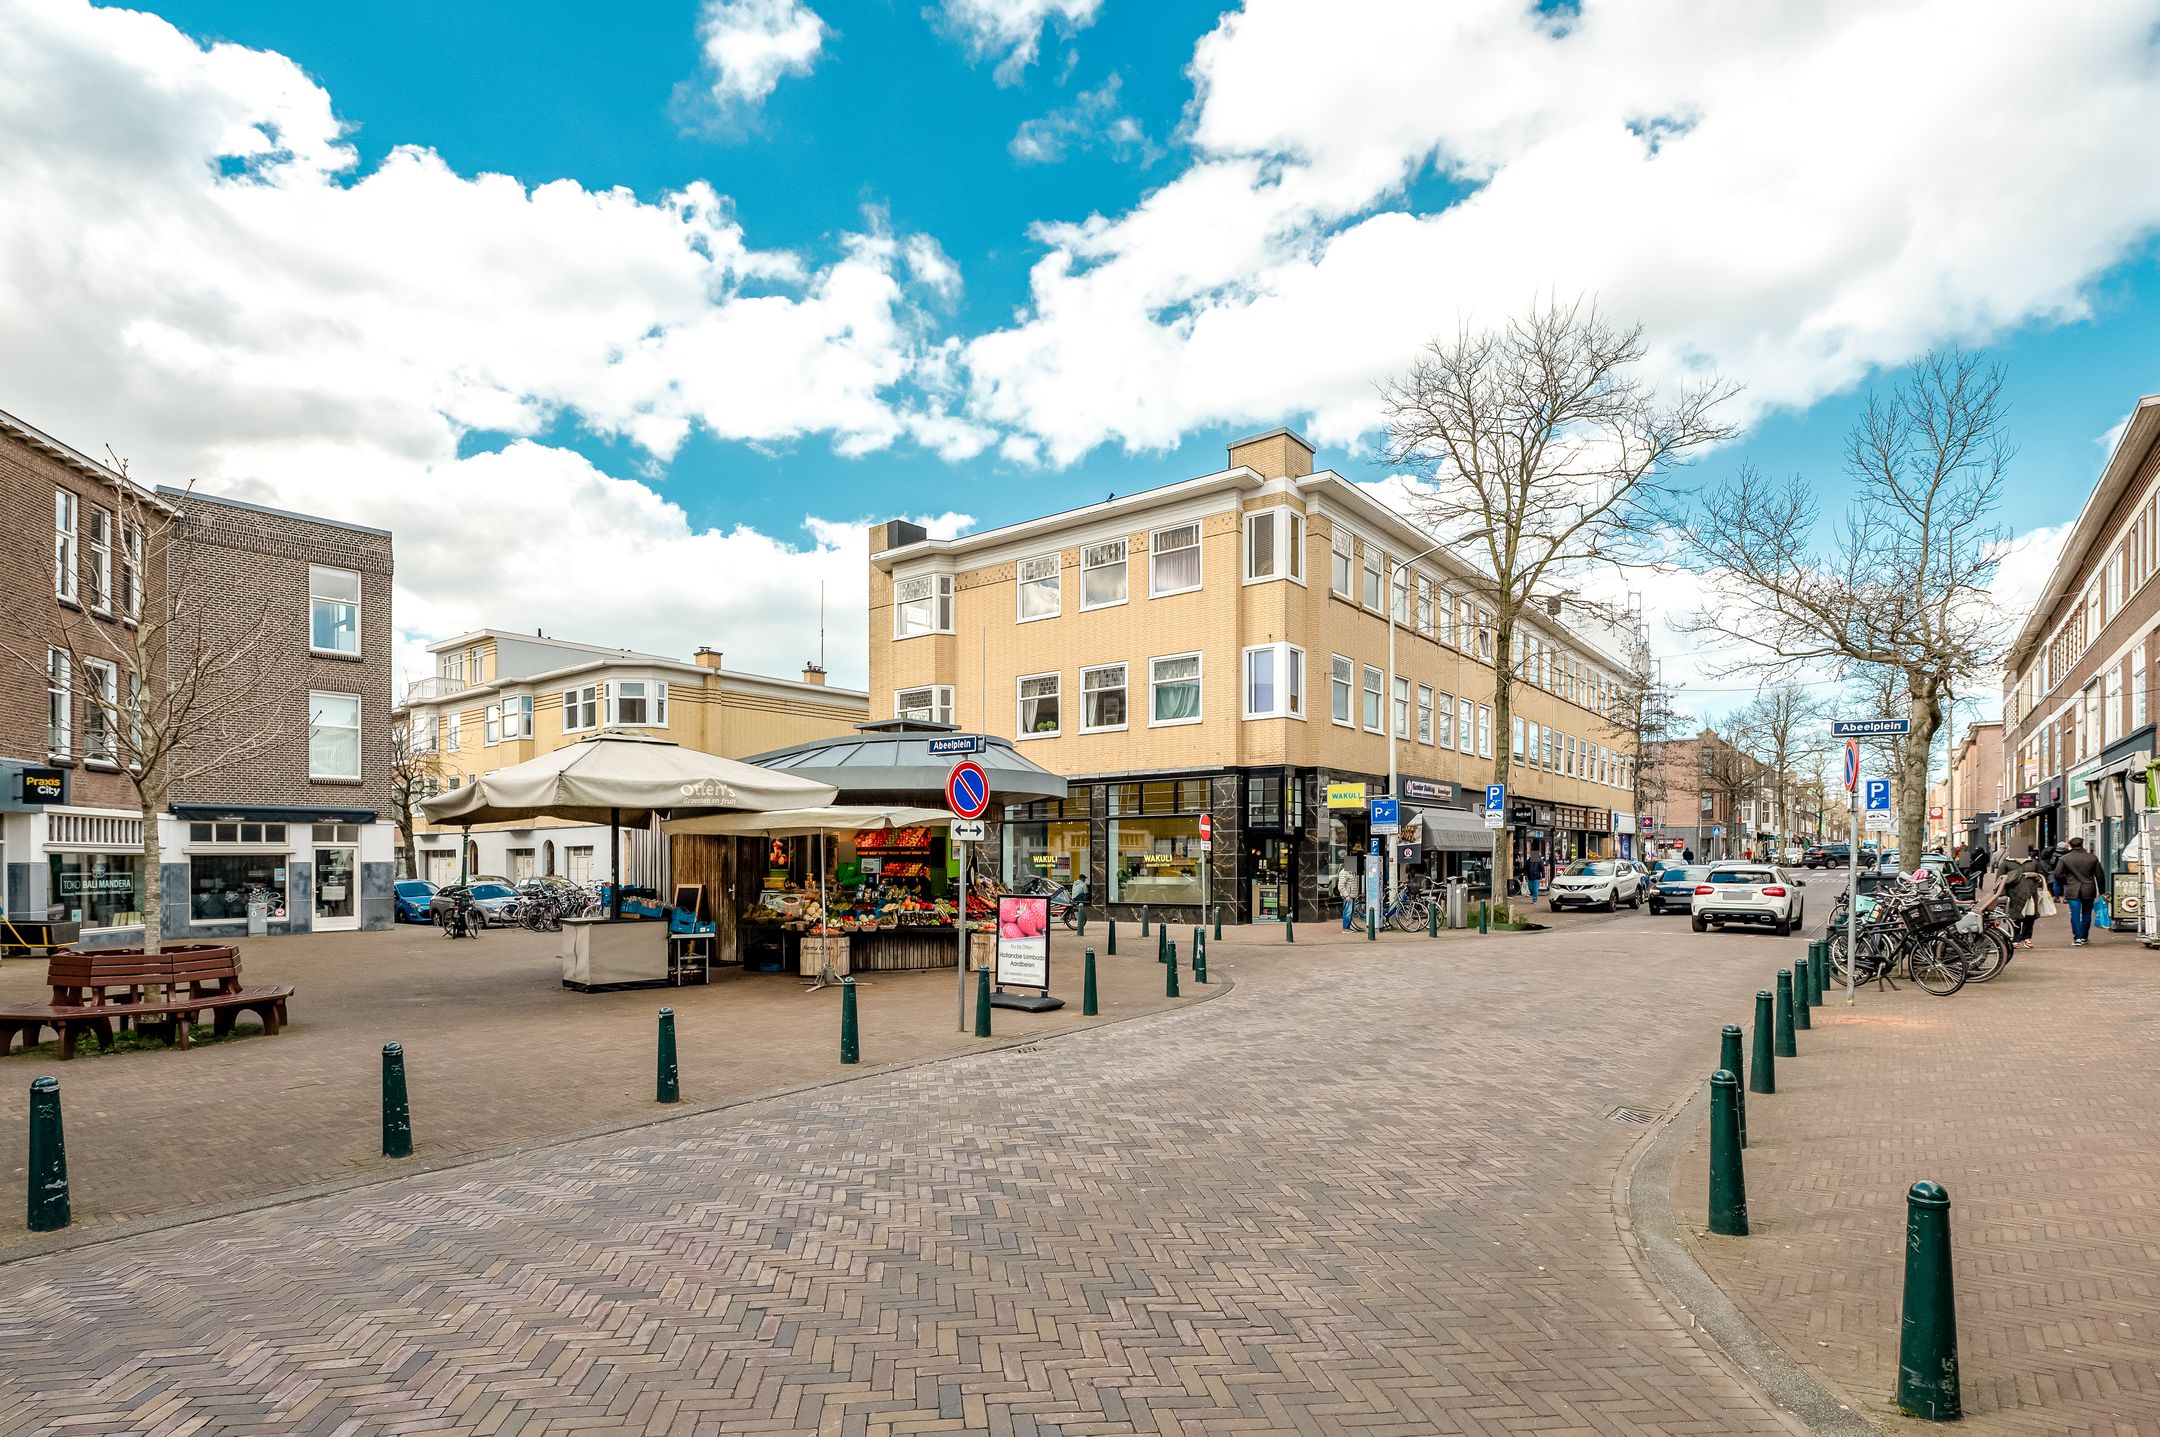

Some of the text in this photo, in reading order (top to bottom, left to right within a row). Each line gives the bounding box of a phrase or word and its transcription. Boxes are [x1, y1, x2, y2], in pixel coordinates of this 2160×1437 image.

[1841, 721, 1902, 732] Abeelplein
[933, 740, 971, 750] Abeelplein
[26, 776, 61, 786] Praxis
[37, 785, 61, 797] City
[680, 783, 736, 797] Otten's
[1490, 787, 1500, 800] P
[1871, 782, 1884, 798] P
[1375, 807, 1383, 818] P
[1033, 855, 1058, 863] WAKULI
[1144, 854, 1173, 863] WAKULI
[63, 879, 131, 889] TOKO BALI MANDERA
[1000, 951, 1022, 959] Hollandse
[1009, 960, 1035, 968] Aardbeien
